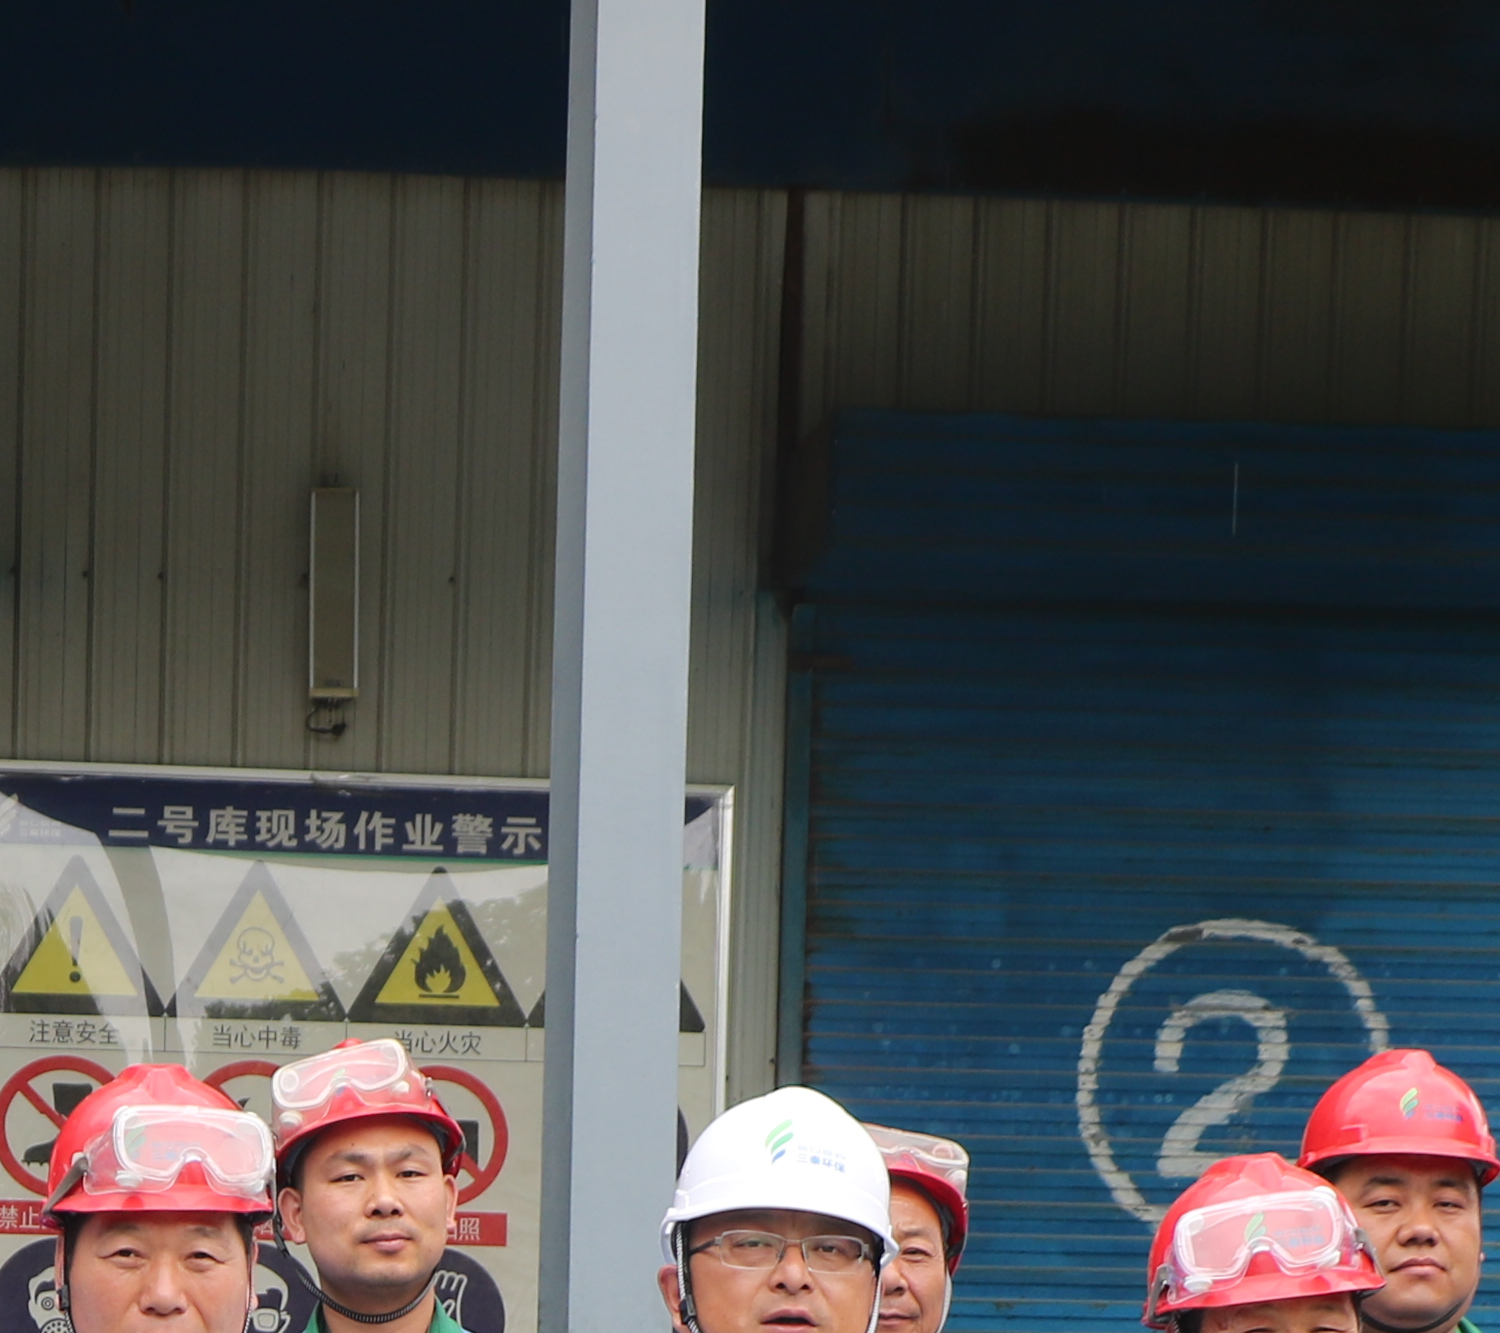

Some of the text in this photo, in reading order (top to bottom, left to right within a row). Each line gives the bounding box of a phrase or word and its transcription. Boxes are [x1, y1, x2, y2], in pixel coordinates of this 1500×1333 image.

[108, 805, 542, 854] 二号库现场作业警示
[29, 1019, 119, 1046] 注意安全
[212, 1023, 301, 1050] 当心中毒
[395, 1029, 483, 1055] 当心火灾
[1154, 989, 1290, 1178] 2
